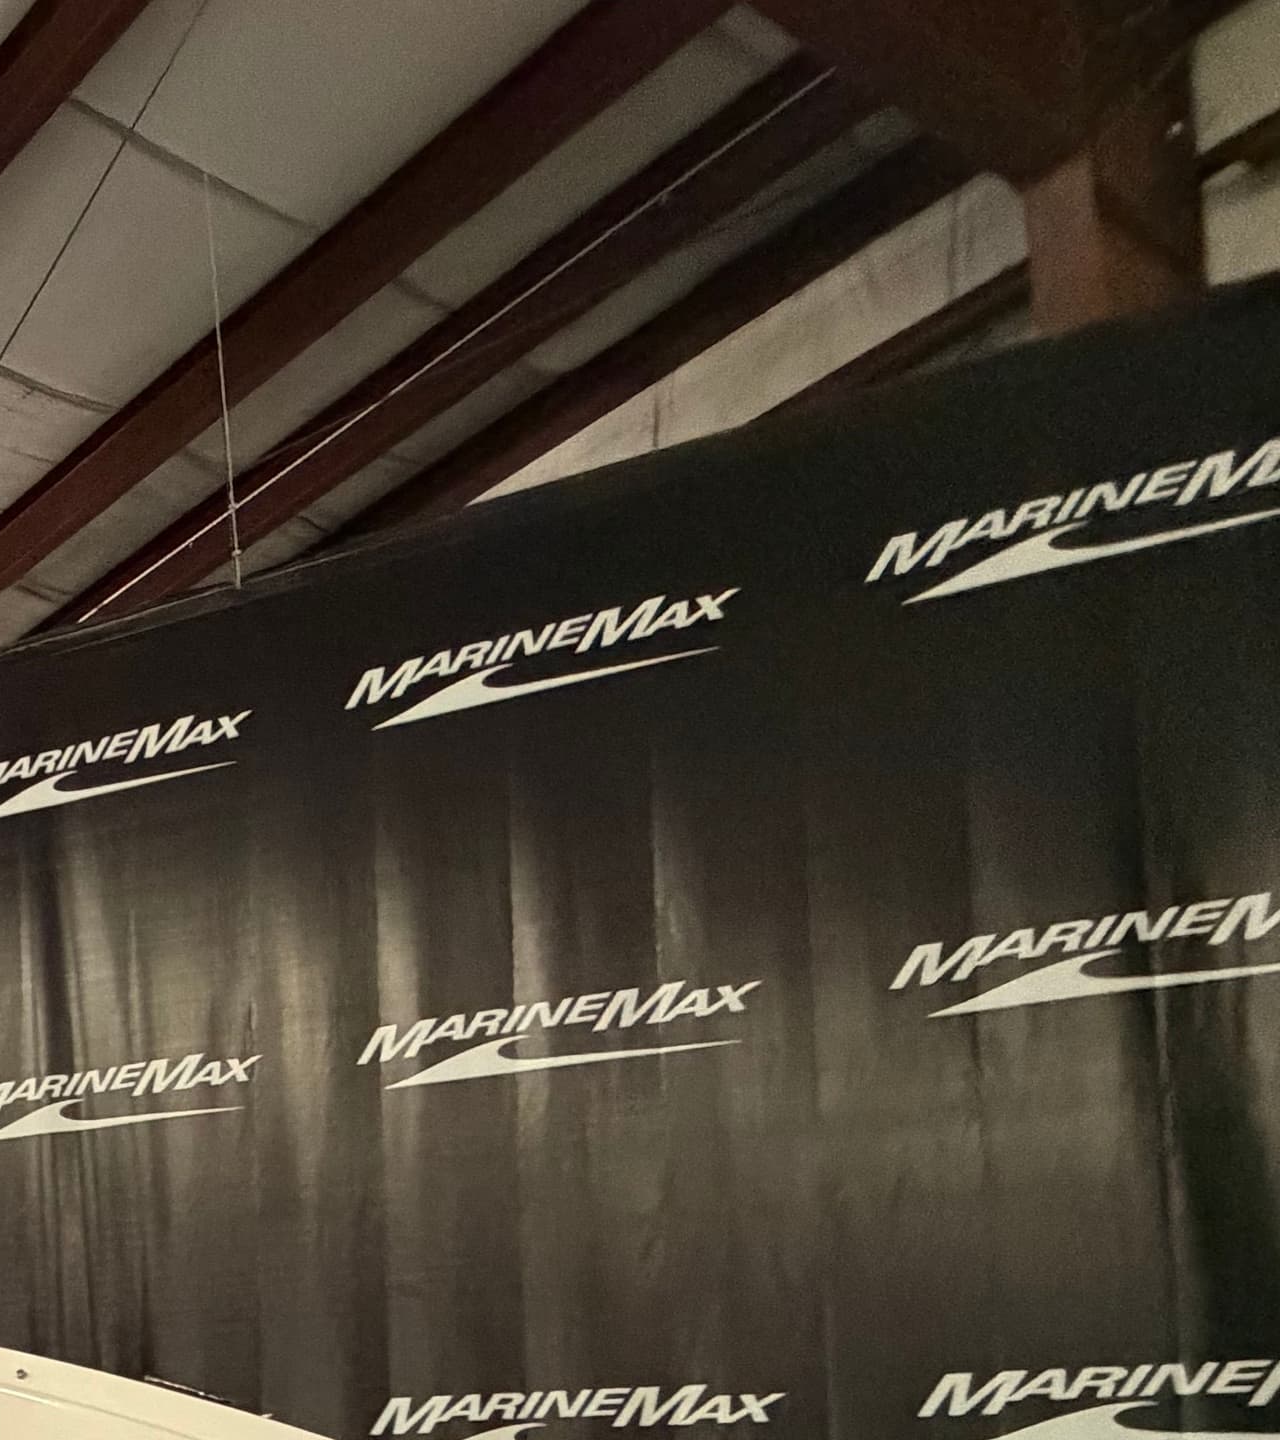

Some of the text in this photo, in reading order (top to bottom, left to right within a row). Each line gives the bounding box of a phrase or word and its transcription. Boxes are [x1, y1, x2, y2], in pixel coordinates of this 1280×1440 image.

[345, 587, 741, 710] MARINEMAX
[357, 979, 762, 1065] MARINEMAX
[370, 1384, 787, 1436] MARINEMAX
[917, 1359, 1280, 1418] MARINE
